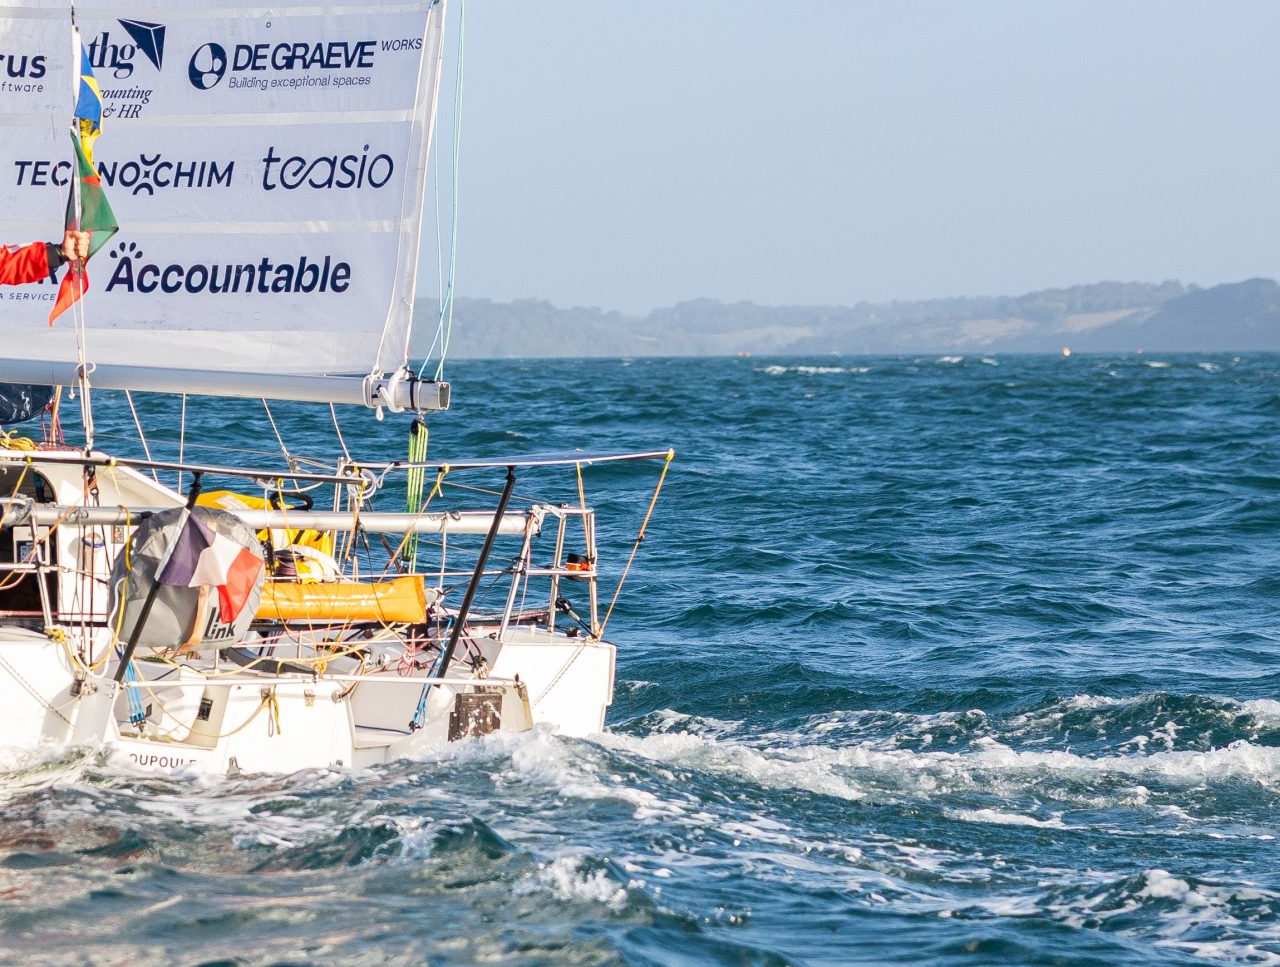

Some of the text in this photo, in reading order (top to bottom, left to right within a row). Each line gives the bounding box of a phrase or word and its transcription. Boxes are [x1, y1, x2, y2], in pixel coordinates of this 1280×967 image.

[87, 31, 142, 79] thg
[232, 38, 422, 72] DE GRAEVE WORKS
[99, 85, 153, 104] ounting
[228, 75, 371, 91] Building exceptional spaces
[118, 104, 143, 118] HR
[14, 160, 235, 189] TECNOCHIM
[262, 144, 394, 190] teasio
[105, 255, 351, 294] Accountable
[9, 292, 56, 301] SERVICE
